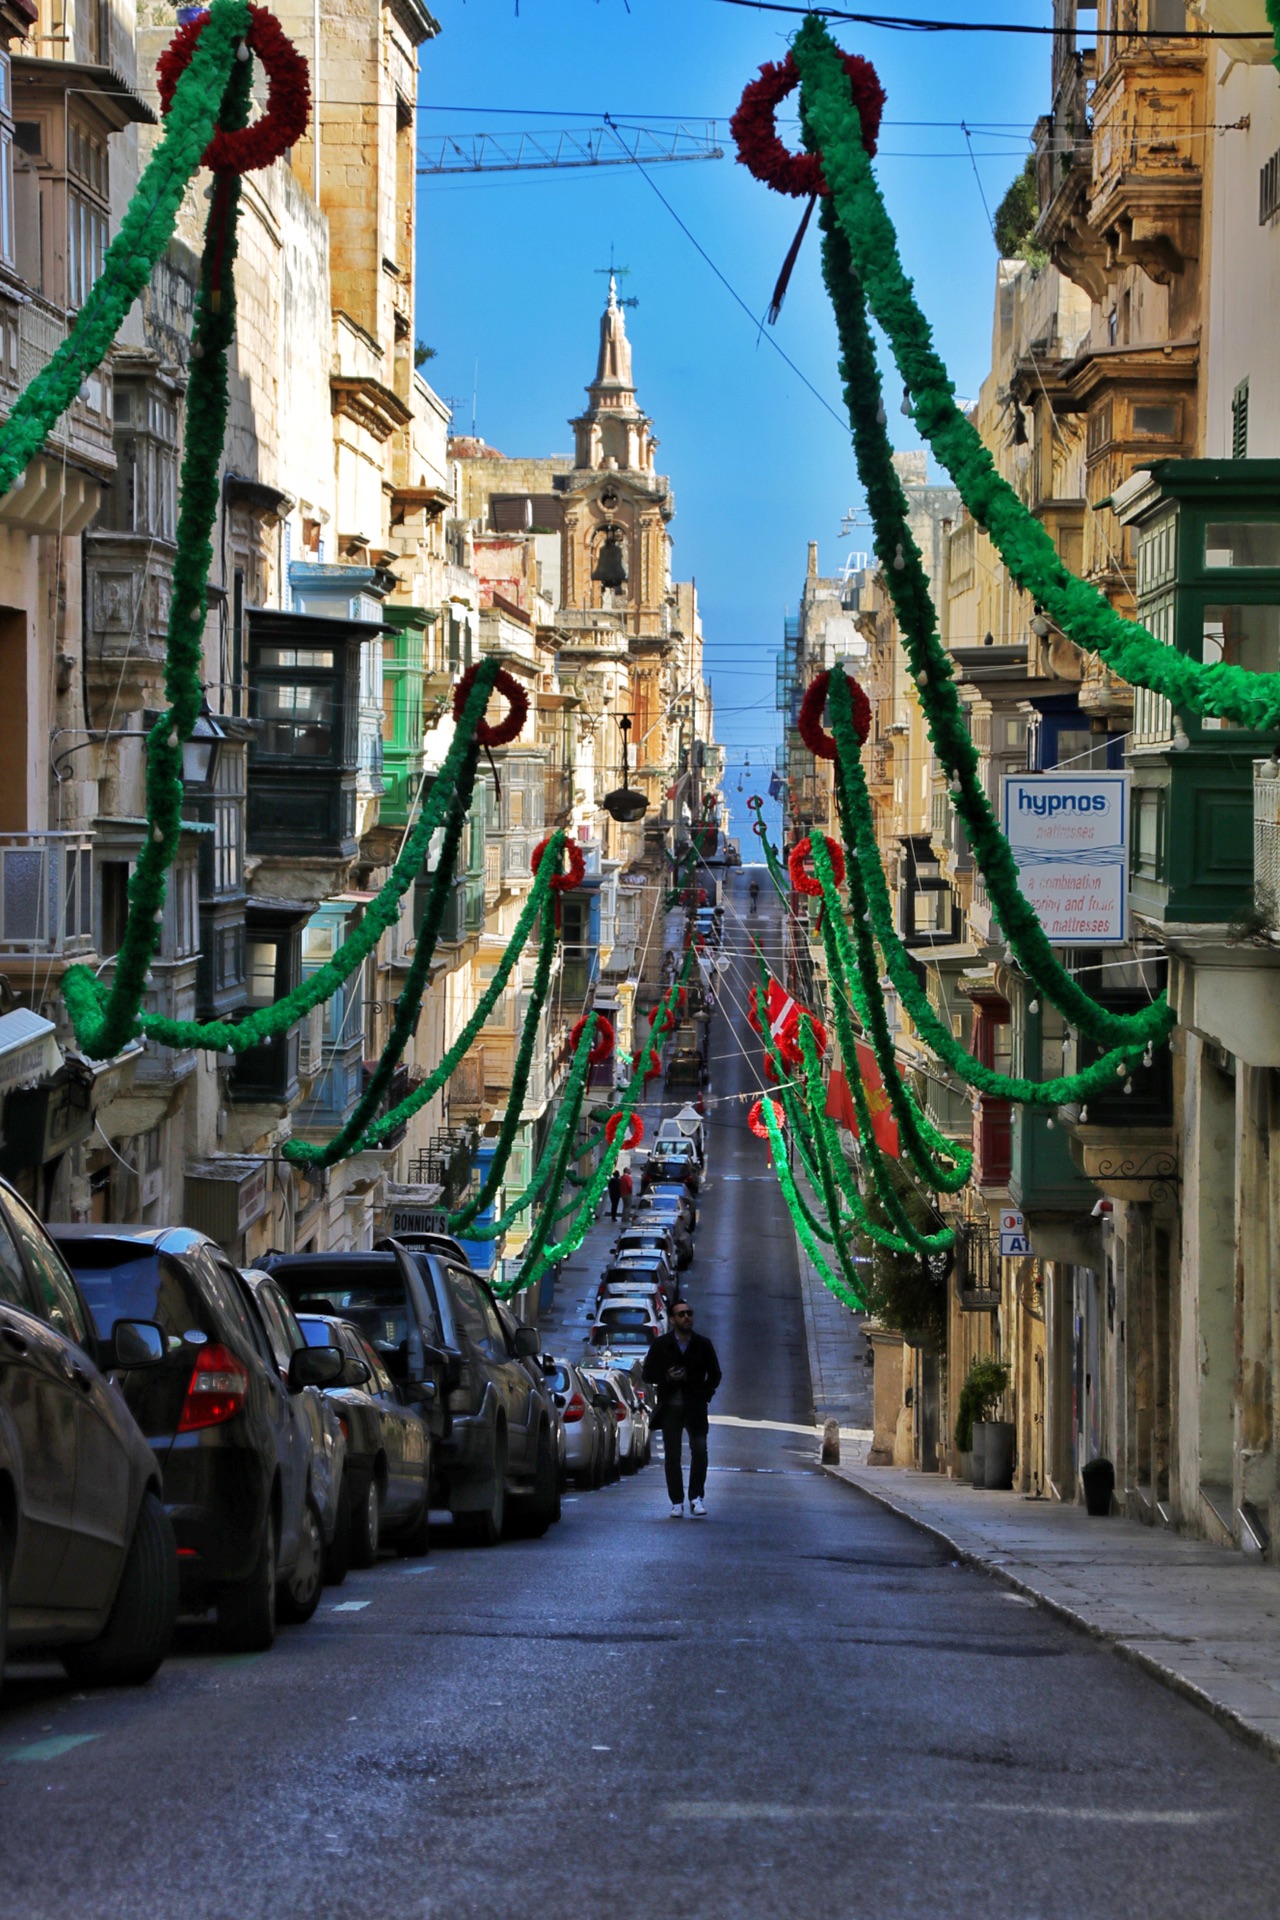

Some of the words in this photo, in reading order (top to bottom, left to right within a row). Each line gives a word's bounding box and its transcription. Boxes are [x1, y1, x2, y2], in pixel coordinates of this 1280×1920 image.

[1018, 787, 1108, 817] hypnos
[1028, 877, 1035, 890] a
[1039, 873, 1101, 890] combination
[1064, 895, 1086, 911] and
[1052, 916, 1110, 933] mattresses
[393, 1213, 446, 1234] BONNICI'S
